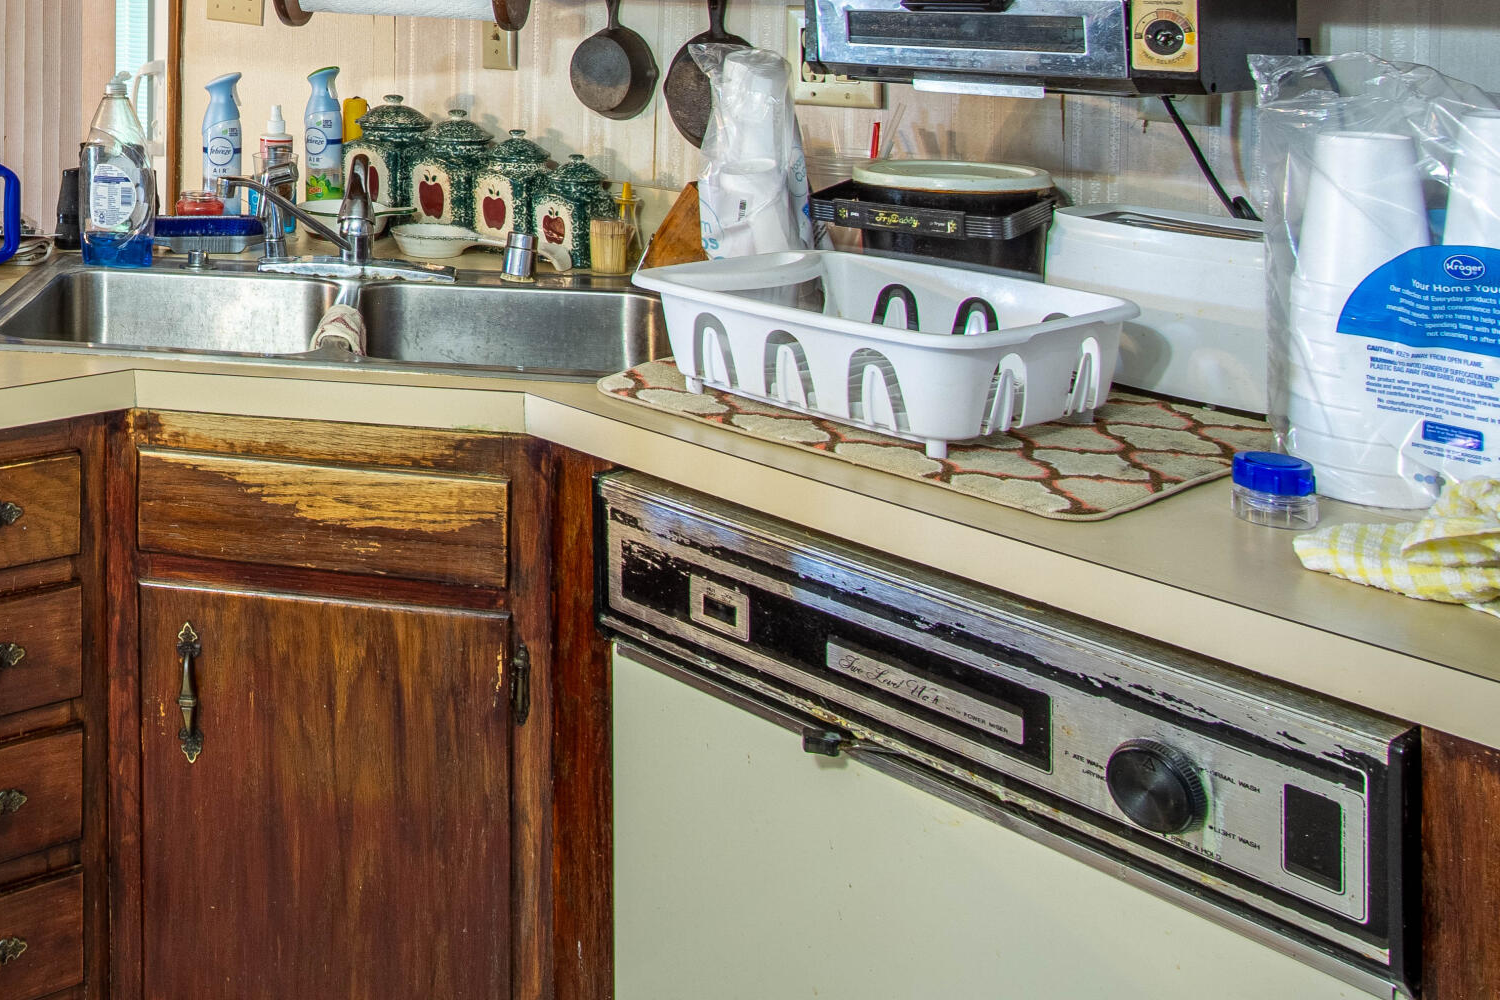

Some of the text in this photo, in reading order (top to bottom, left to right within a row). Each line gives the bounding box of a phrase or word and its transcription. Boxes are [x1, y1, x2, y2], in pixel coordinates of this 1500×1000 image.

[209, 145, 232, 156] febreze
[1446, 260, 1483, 276] Kroger
[1412, 278, 1500, 294] Your Home You
[906, 679, 940, 705] Wah
[963, 712, 987, 726] POWER
[1238, 780, 1260, 793] WASH
[1238, 836, 1261, 850] WASH
